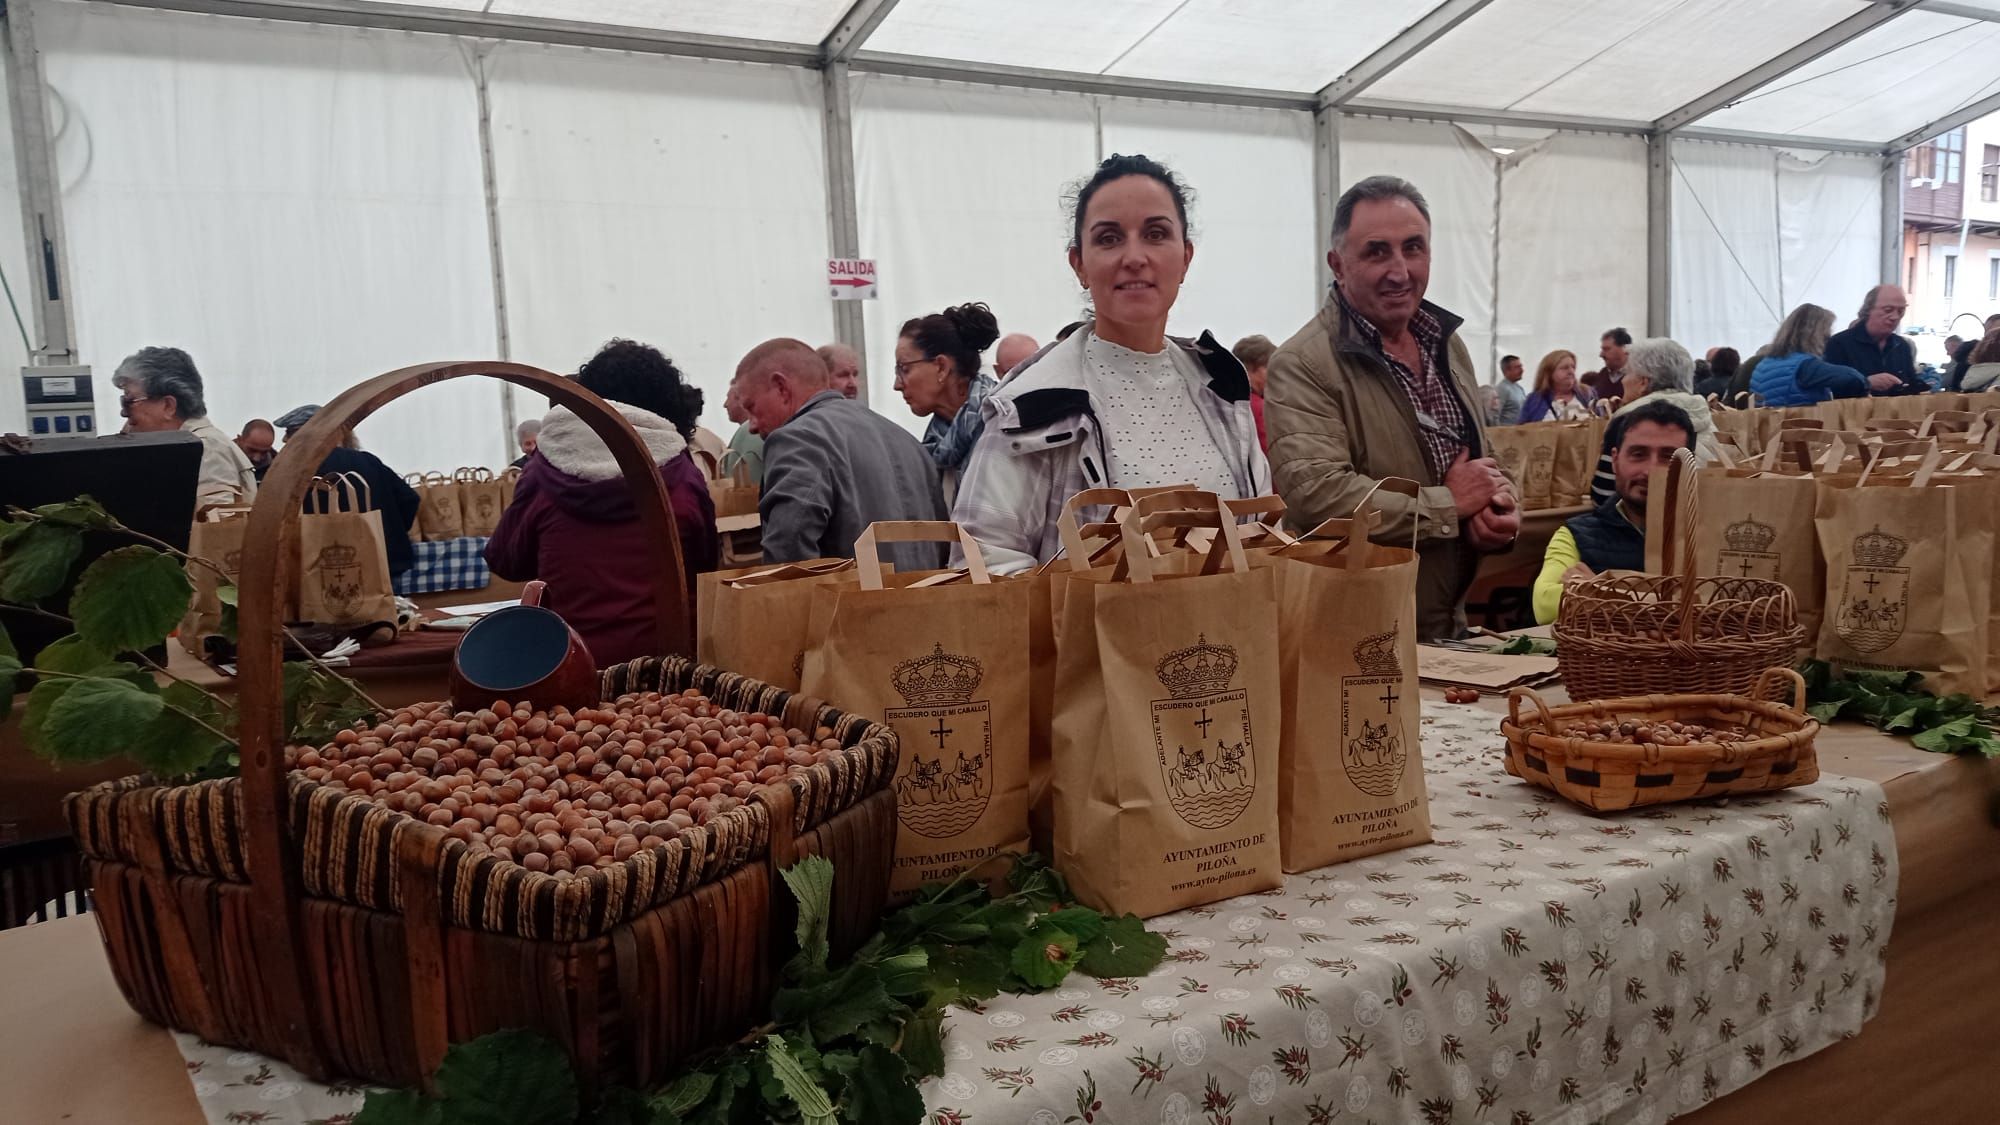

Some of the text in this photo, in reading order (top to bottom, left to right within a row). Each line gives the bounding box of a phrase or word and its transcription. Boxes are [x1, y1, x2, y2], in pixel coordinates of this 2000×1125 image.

[828, 260, 875, 275] SALIDA
[1344, 678, 1379, 687] ESCUDERO
[1381, 677, 1395, 685] QUE
[1154, 702, 1194, 711] ESCUDERO
[1195, 699, 1209, 708] QUE
[1216, 693, 1245, 704] CABALLO
[1343, 689, 1349, 698] MI
[888, 704, 988, 719] ESCUDERO QUE MI CABALLO
[1240, 708, 1251, 747] PIE HALLA
[1154, 714, 1167, 766] ADELANTE MI
[1331, 801, 1409, 825] AYUNTAMIENTO
[1361, 818, 1398, 834] PILOÑA
[1163, 833, 1266, 863] AYUNTAMIENTO DE
[1196, 855, 1237, 873] PILOÑA
[1171, 867, 1257, 892] www.ayto-pilona.es
